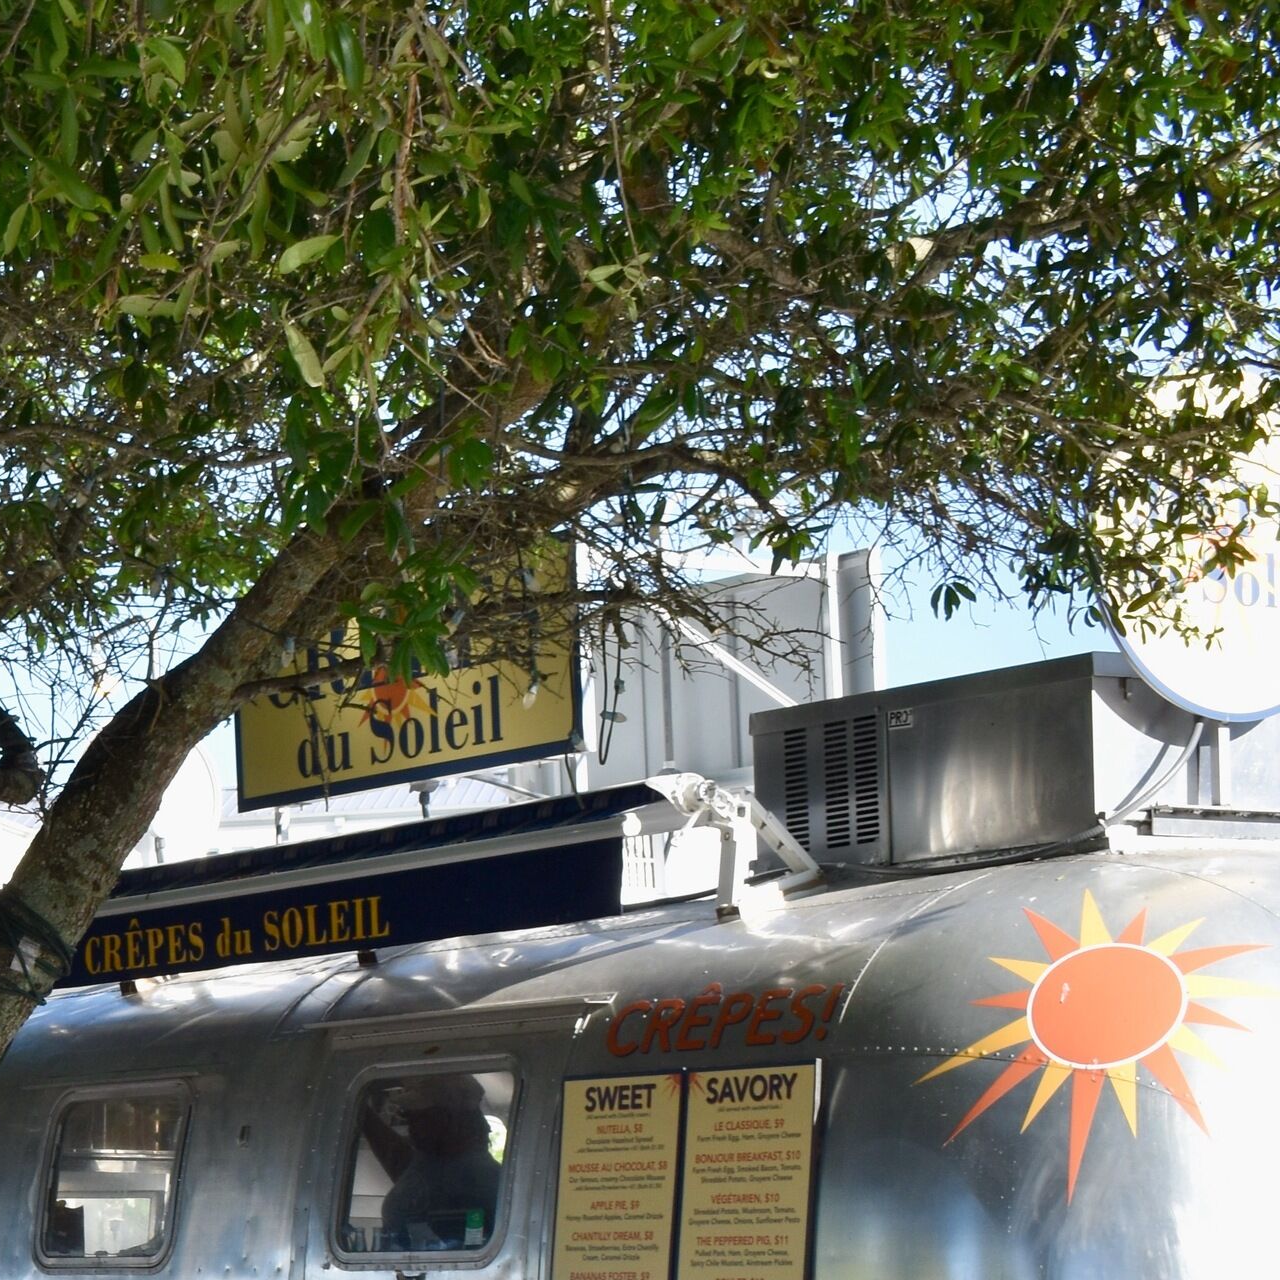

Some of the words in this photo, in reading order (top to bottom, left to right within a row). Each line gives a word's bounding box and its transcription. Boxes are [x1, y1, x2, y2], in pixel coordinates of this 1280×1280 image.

[297, 714, 353, 779] du
[369, 674, 504, 764] Soleil
[84, 918, 205, 977] CRÊPES
[216, 917, 252, 958] du
[264, 896, 389, 951] SOLEIL
[605, 982, 847, 1057] CRÊPES!
[706, 1073, 798, 1104] SAVORY
[585, 1084, 657, 1112] SWEET
[597, 1124, 631, 1135] NUTELLA,
[714, 1122, 723, 1132] LE
[726, 1119, 772, 1131] CLASSIQUE,
[695, 1153, 735, 1164] BONJOUR
[737, 1151, 783, 1163] BREAKFAST,
[785, 1150, 801, 1160] $10
[765, 1193, 780, 1203] $10
[591, 1201, 614, 1211] APPLE
[615, 1200, 628, 1210] PIE,
[572, 1232, 612, 1241] CHANTILLY
[613, 1231, 642, 1241] DREAM,
[697, 1237, 712, 1246] THE
[714, 1236, 754, 1246] PEPPERED
[756, 1236, 772, 1246] PIG,
[774, 1236, 789, 1245] $11
[570, 1272, 607, 1280] BANANAS
